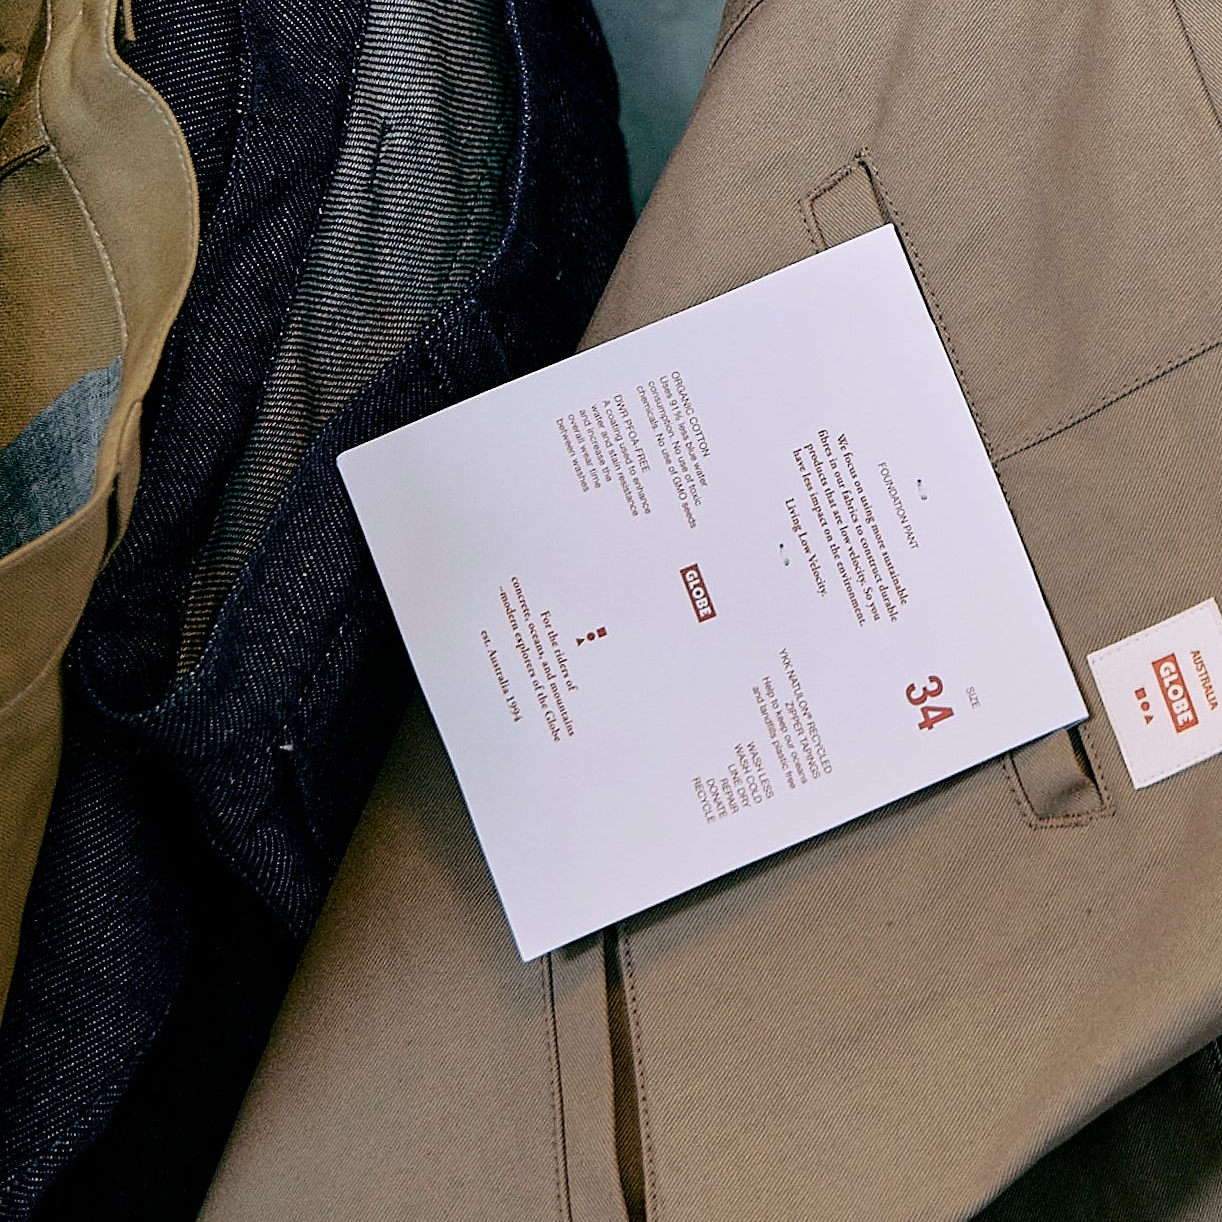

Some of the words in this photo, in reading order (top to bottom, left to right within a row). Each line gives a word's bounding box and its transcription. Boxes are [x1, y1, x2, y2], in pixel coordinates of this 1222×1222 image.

[602, 400, 611, 408] A
[605, 408, 624, 442] coating
[636, 385, 660, 432] chemicals.
[671, 370, 695, 416] ORGANIC
[689, 416, 711, 458] COTTON
[567, 413, 586, 444] overall
[580, 444, 594, 467] wear
[588, 467, 602, 489] time
[578, 409, 593, 427] and
[586, 427, 606, 466] increase
[601, 466, 612, 483] the
[613, 394, 630, 419] DWR
[623, 418, 651, 474] PFOA-FREE
[655, 432, 666, 448] No
[659, 375, 673, 399] Uses
[668, 399, 684, 421] 91%
[677, 421, 690, 442] less
[684, 440, 698, 462] blue
[693, 462, 708, 487] water
[671, 440, 682, 455] No
[836, 433, 849, 452] We
[555, 417, 576, 457] between
[571, 457, 590, 493] washes
[591, 403, 606, 429] water
[600, 430, 614, 449] and
[608, 449, 622, 472] stain
[617, 471, 639, 517] resistance
[618, 442, 634, 466] used
[627, 465, 637, 476] to
[660, 448, 672, 465] use
[667, 465, 679, 476] of
[677, 455, 689, 473] use
[803, 442, 828, 487] products
[842, 451, 858, 480] focus
[632, 476, 652, 515] enhance
[672, 476, 688, 501] GMO
[684, 473, 695, 484] of
[688, 483, 703, 507] toxic
[823, 487, 838, 509] that
[853, 480, 864, 495] on
[681, 501, 697, 529] seeds
[817, 429, 833, 458] fibres
[828, 457, 838, 470] in
[833, 470, 846, 489] our
[841, 489, 859, 524] fabrics
[854, 524, 864, 536] to
[859, 536, 883, 584] construct
[878, 584, 899, 623] durable
[832, 509, 844, 525] are
[860, 495, 876, 525] using
[877, 461, 909, 525] FOUNDATION
[902, 524, 920, 550] PANT
[784, 497, 803, 533] Living
[797, 531, 812, 554] Low
[808, 553, 828, 598] Velocity.
[792, 447, 806, 473] have
[801, 471, 814, 492] less
[809, 491, 828, 528] impact
[823, 528, 834, 543] on
[829, 543, 841, 561] the
[836, 561, 866, 627] environment.
[838, 524, 852, 545] low
[870, 523, 886, 551] more
[847, 545, 867, 587] velocity.
[881, 551, 910, 606] sustainable
[510, 576, 531, 622] concrete,
[683, 568, 713, 618] GLOBE
[862, 586, 874, 601] So
[865, 601, 881, 622] you
[514, 632, 536, 678] explorers
[527, 622, 545, 660] oceans,
[540, 609, 552, 629] For
[547, 630, 559, 648] the
[553, 648, 570, 679] riders
[565, 679, 579, 692] of
[480, 629, 492, 648] est.
[487, 649, 511, 695] Australia
[506, 695, 523, 723] 1994
[532, 679, 546, 692] of
[541, 661, 558, 681] and
[1189, 649, 1219, 712] AUSTRALIA
[536, 691, 549, 710] the
[549, 682, 575, 737] mountains
[778, 646, 793, 671] YKK
[806, 721, 833, 774] RECYCLED
[905, 675, 955, 731] 34
[965, 686, 981, 709] SIZE
[1157, 659, 1195, 728] GLOBE
[544, 710, 561, 742] Globe
[752, 686, 766, 705] and
[759, 703, 777, 740] landfills
[770, 739, 789, 770] plastic
[784, 770, 796, 790] free
[761, 675, 775, 699] Help
[770, 698, 780, 710] to
[775, 709, 789, 734] keep
[784, 734, 795, 749] our
[790, 751, 808, 785] oceans
[784, 700, 805, 737] ZIPPER
[799, 736, 822, 780] TAPINGS
[727, 763, 744, 787] LINE
[736, 786, 752, 808] DRY
[734, 742, 752, 775] WASH
[745, 774, 763, 804] COLD
[746, 741, 765, 773] WASH
[758, 772, 775, 799] LESS
[691, 776, 716, 824] RECYCLE
[705, 777, 728, 819] DONATE
[719, 777, 740, 815] REPAIR
